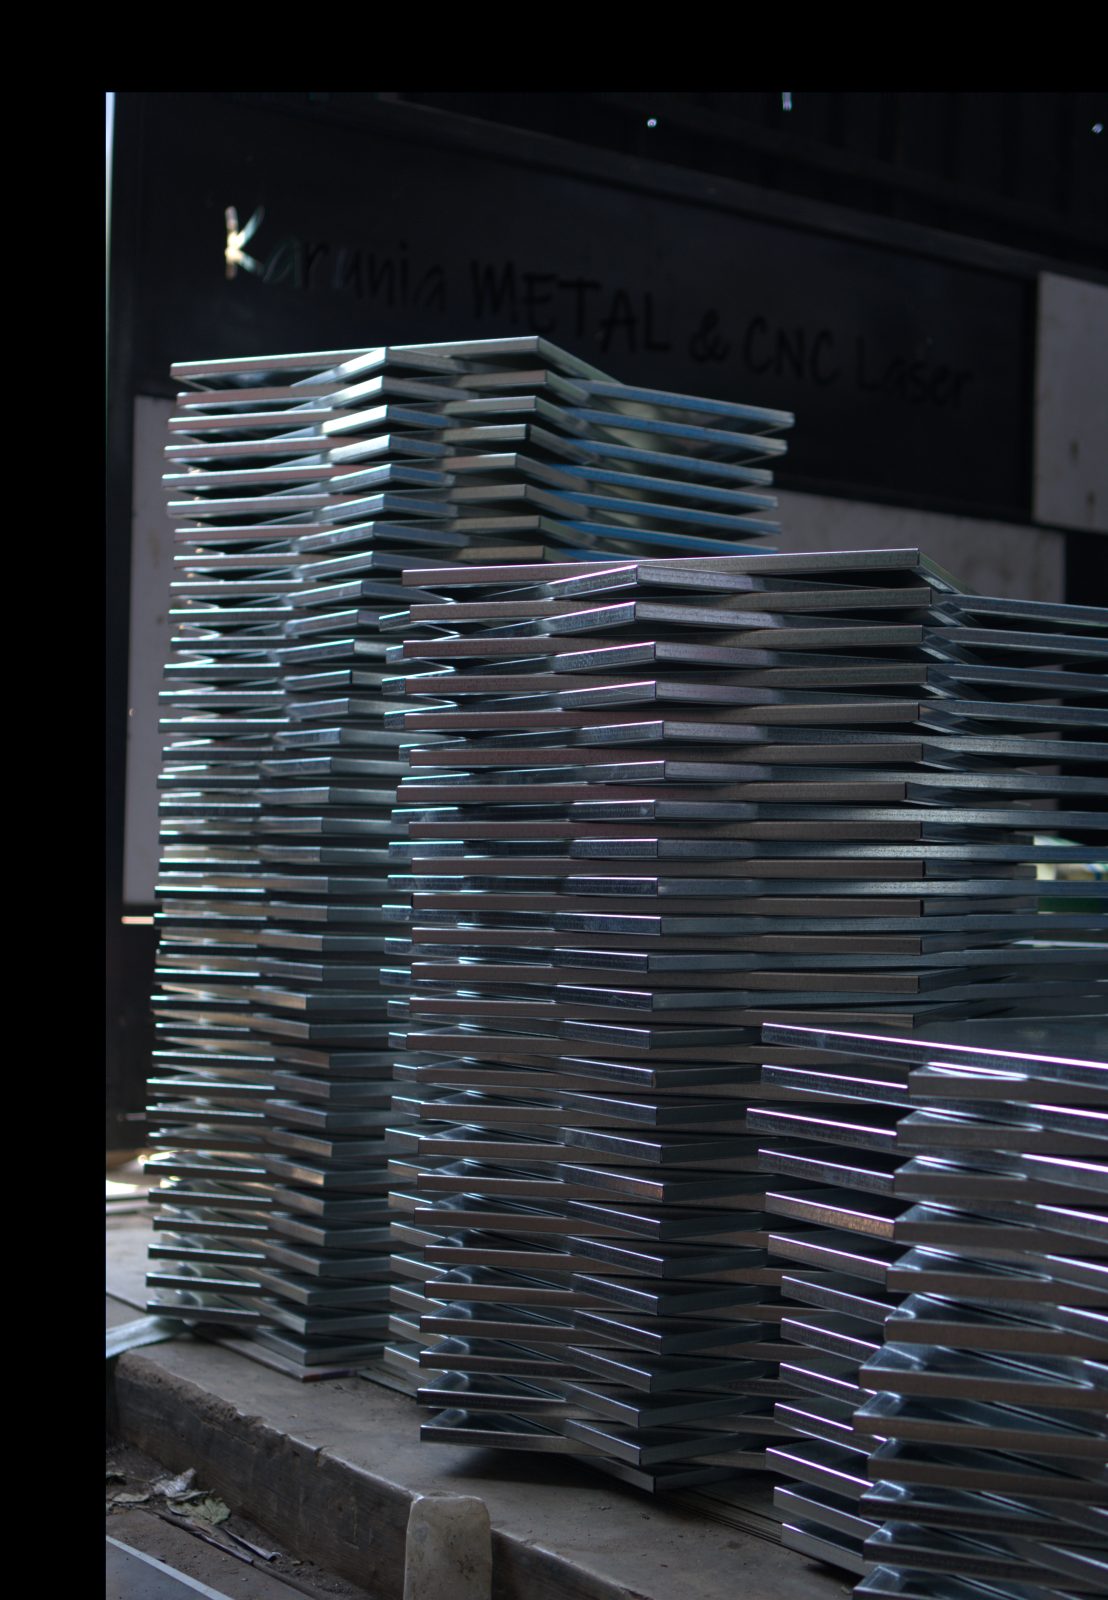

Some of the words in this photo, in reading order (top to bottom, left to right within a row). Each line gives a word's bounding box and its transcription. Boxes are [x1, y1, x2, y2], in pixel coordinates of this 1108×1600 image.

[224, 204, 446, 312] Karunia
[471, 259, 671, 354] METAL
[690, 308, 729, 364] &
[743, 316, 838, 385] CNC
[856, 335, 975, 408] Laser
